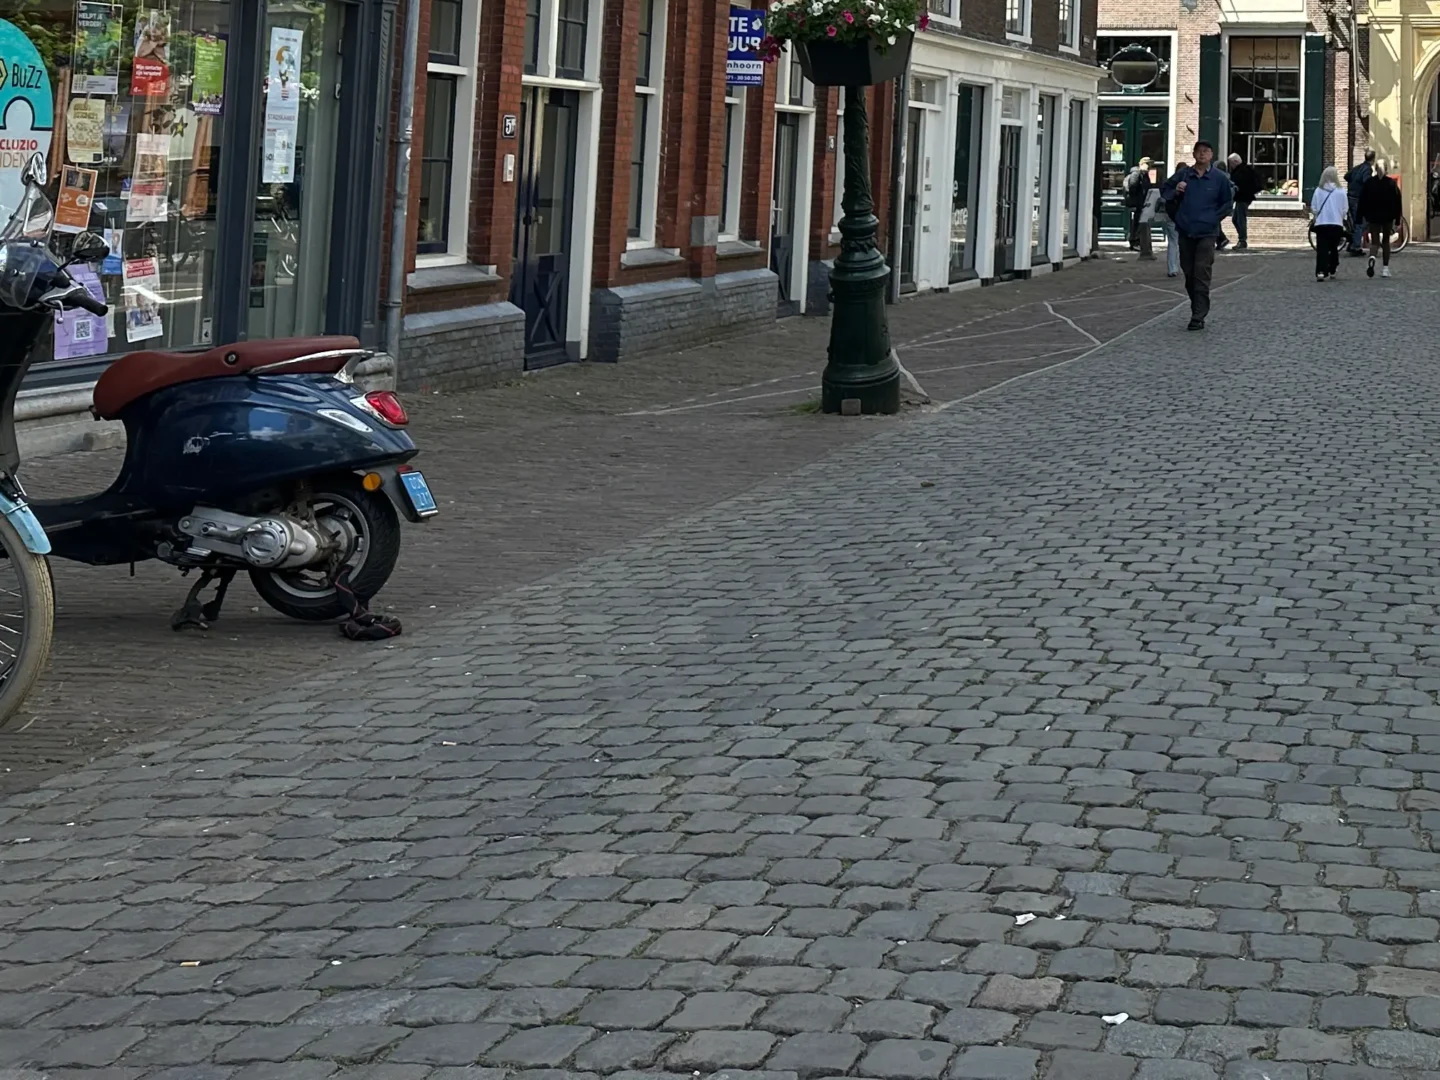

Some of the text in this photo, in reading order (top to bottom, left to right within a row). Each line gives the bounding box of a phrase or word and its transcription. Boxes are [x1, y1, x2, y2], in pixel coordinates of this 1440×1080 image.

[728, 16, 749, 33] TE
[727, 61, 762, 70] nhoorn
[0, 138, 38, 151] CLUZIO
